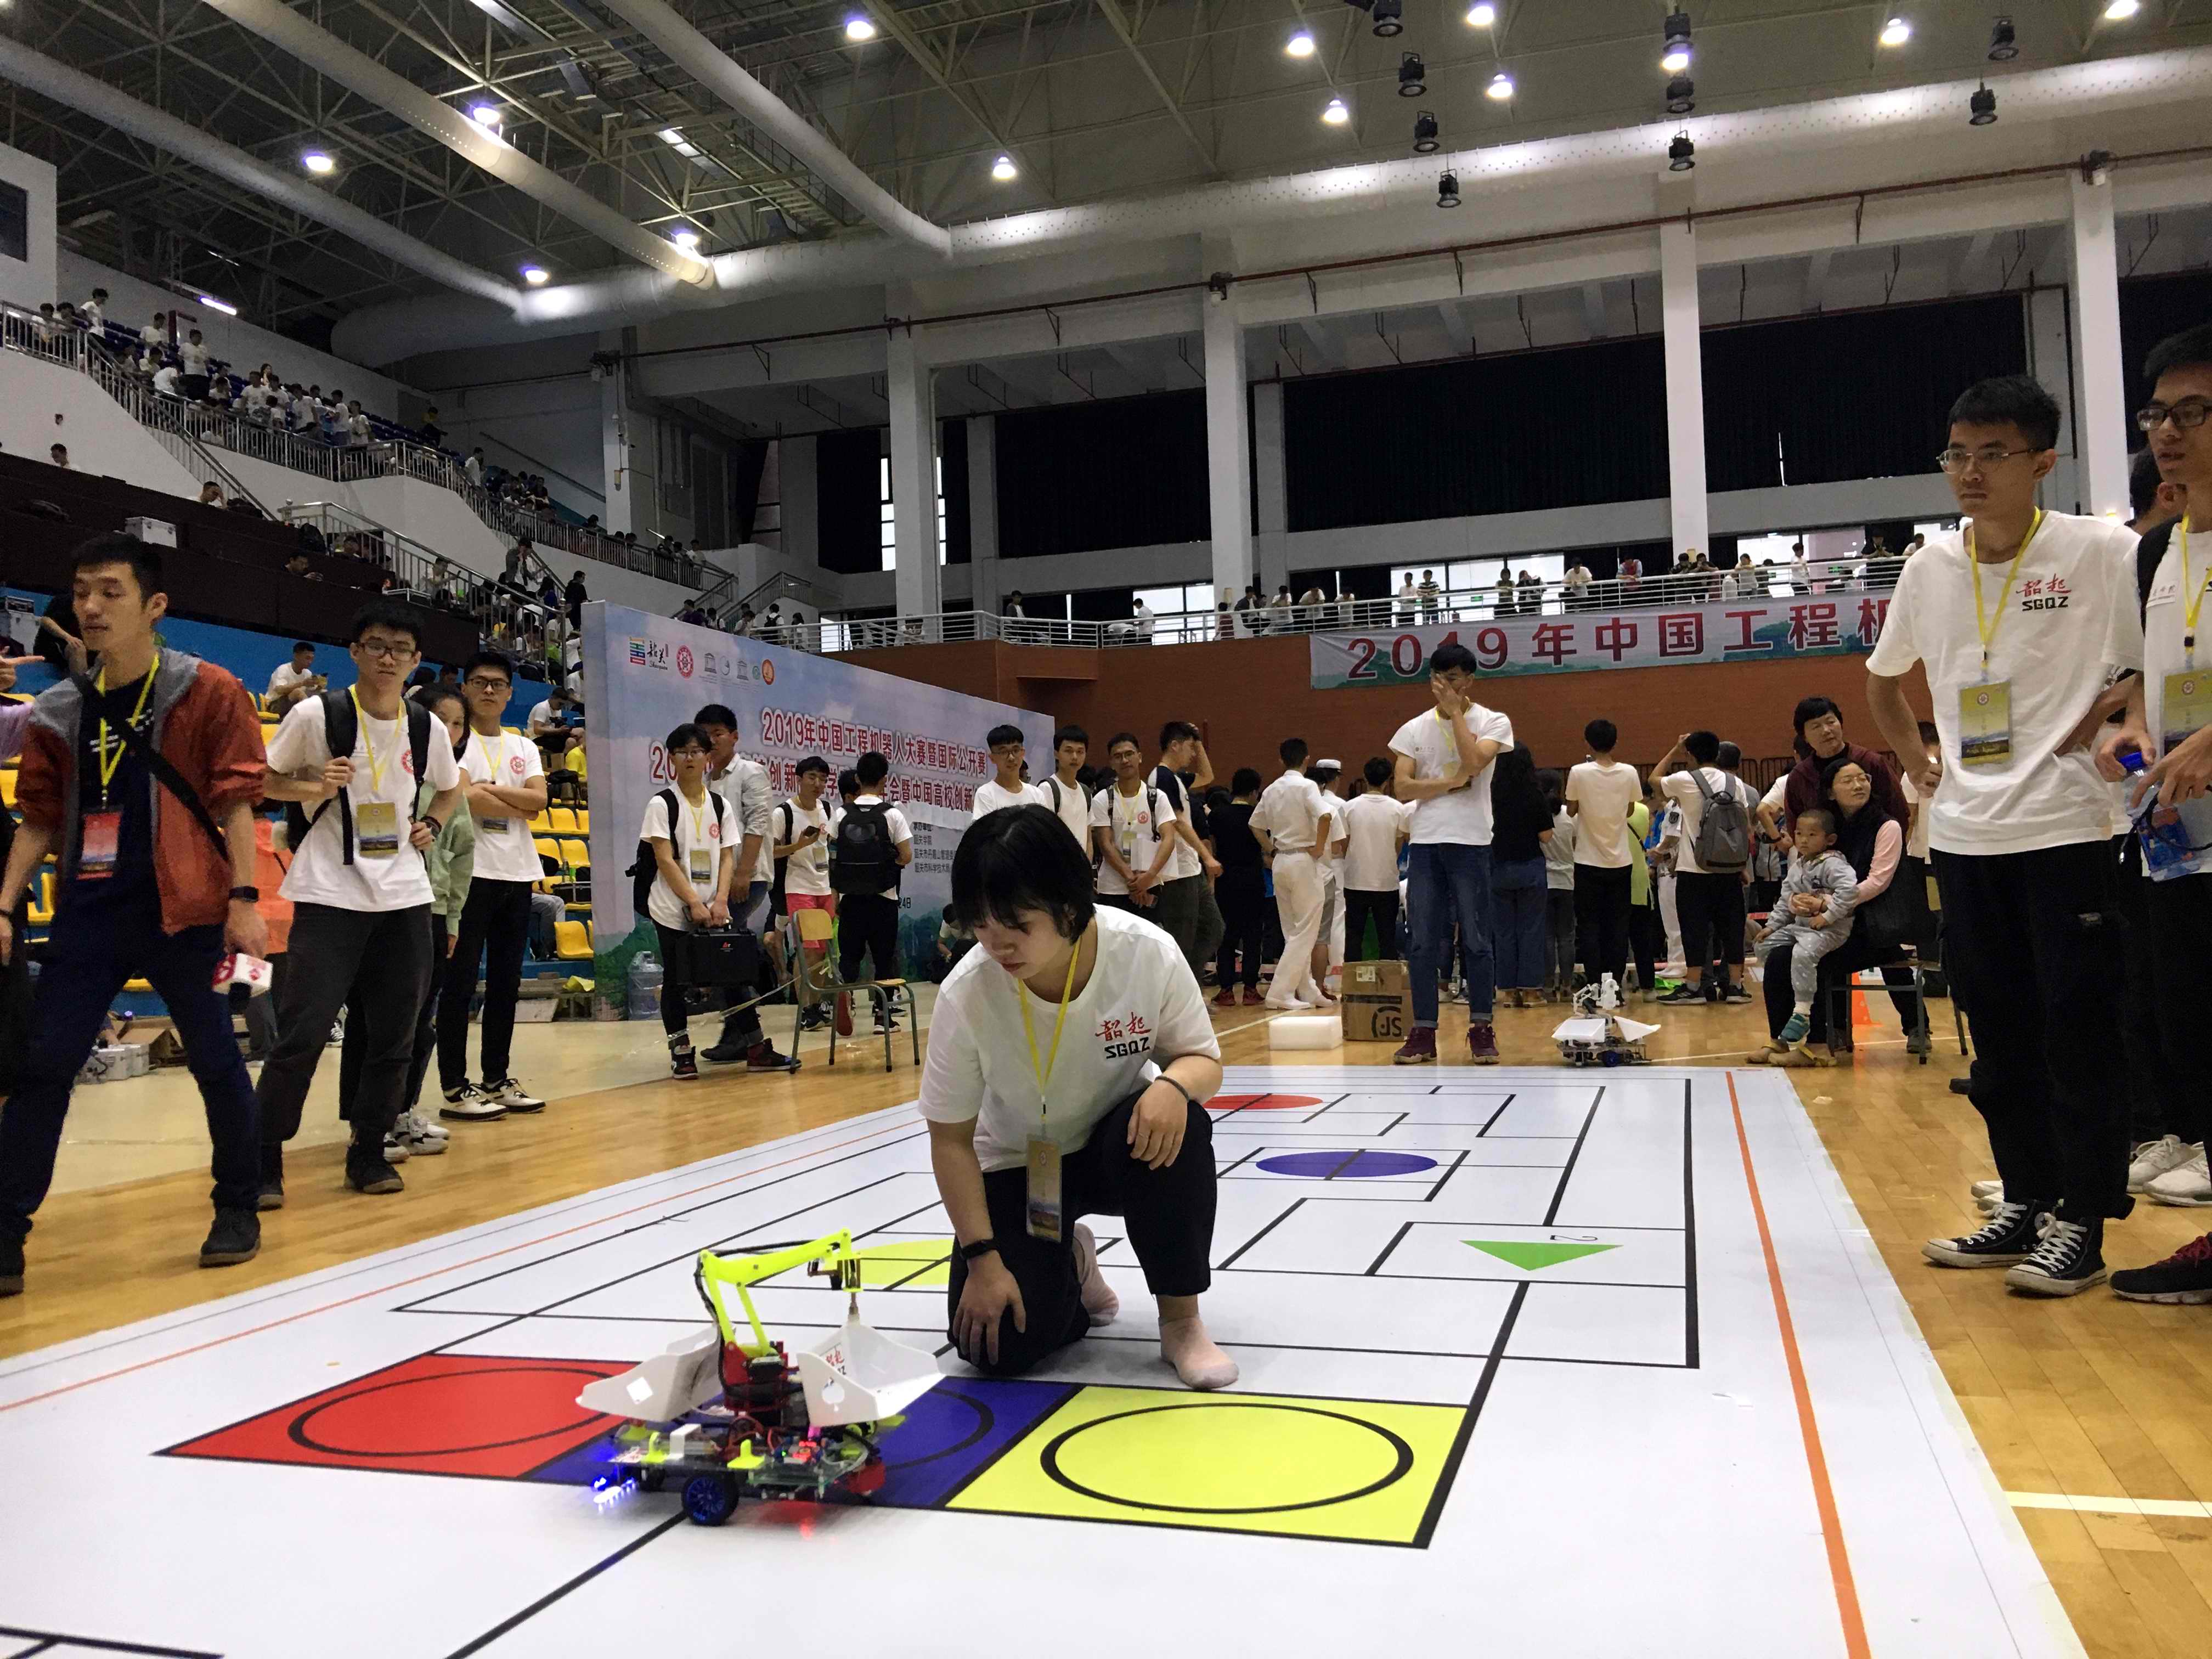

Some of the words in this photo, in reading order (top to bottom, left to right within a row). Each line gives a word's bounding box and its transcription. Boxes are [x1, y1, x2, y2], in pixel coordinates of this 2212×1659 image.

[2022, 596, 2069, 612] SGQZ
[763, 710, 986, 775] 2019年中国工程机器人大赛暨国际公开赛
[1104, 1036, 1150, 1059] SGQZ
